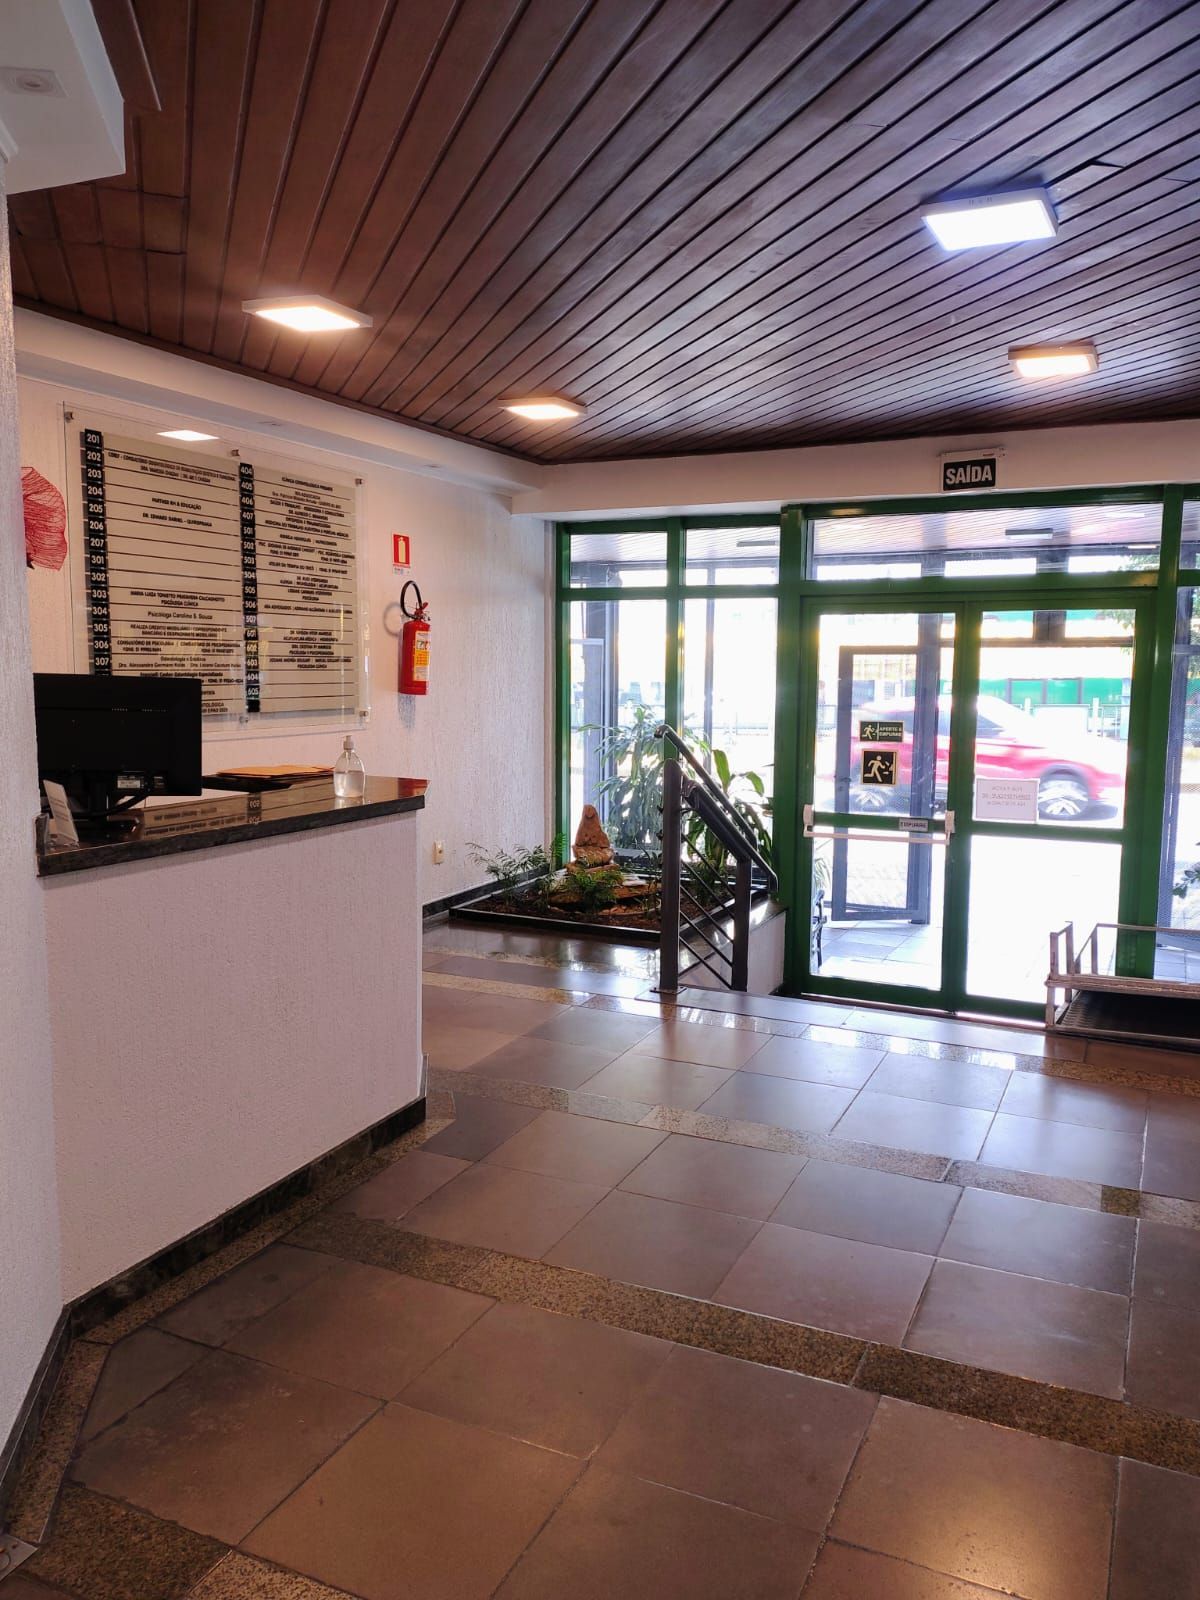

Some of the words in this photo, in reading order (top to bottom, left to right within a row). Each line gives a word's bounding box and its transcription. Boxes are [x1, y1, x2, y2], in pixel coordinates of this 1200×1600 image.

[87, 433, 100, 443] 201
[87, 452, 101, 461] 202
[87, 468, 101, 478] 203
[241, 466, 252, 475] 404
[945, 464, 993, 485] SAÍDA
[88, 485, 102, 495] 204
[241, 482, 253, 490] 405
[242, 497, 253, 505] 406
[89, 504, 103, 513] 205
[242, 512, 253, 520] 407
[90, 521, 103, 530] 206
[243, 527, 253, 535] 501
[90, 538, 104, 547] 207
[243, 541, 254, 550] 502
[91, 555, 104, 564] 301
[244, 556, 254, 564] 503
[92, 572, 106, 581] 302
[92, 589, 106, 598] 303
[245, 586, 256, 594] 505
[93, 606, 107, 614] 304
[94, 624, 108, 632] 305
[94, 640, 108, 649] 306
[96, 657, 109, 666] 307
[247, 673, 258, 681] 604
